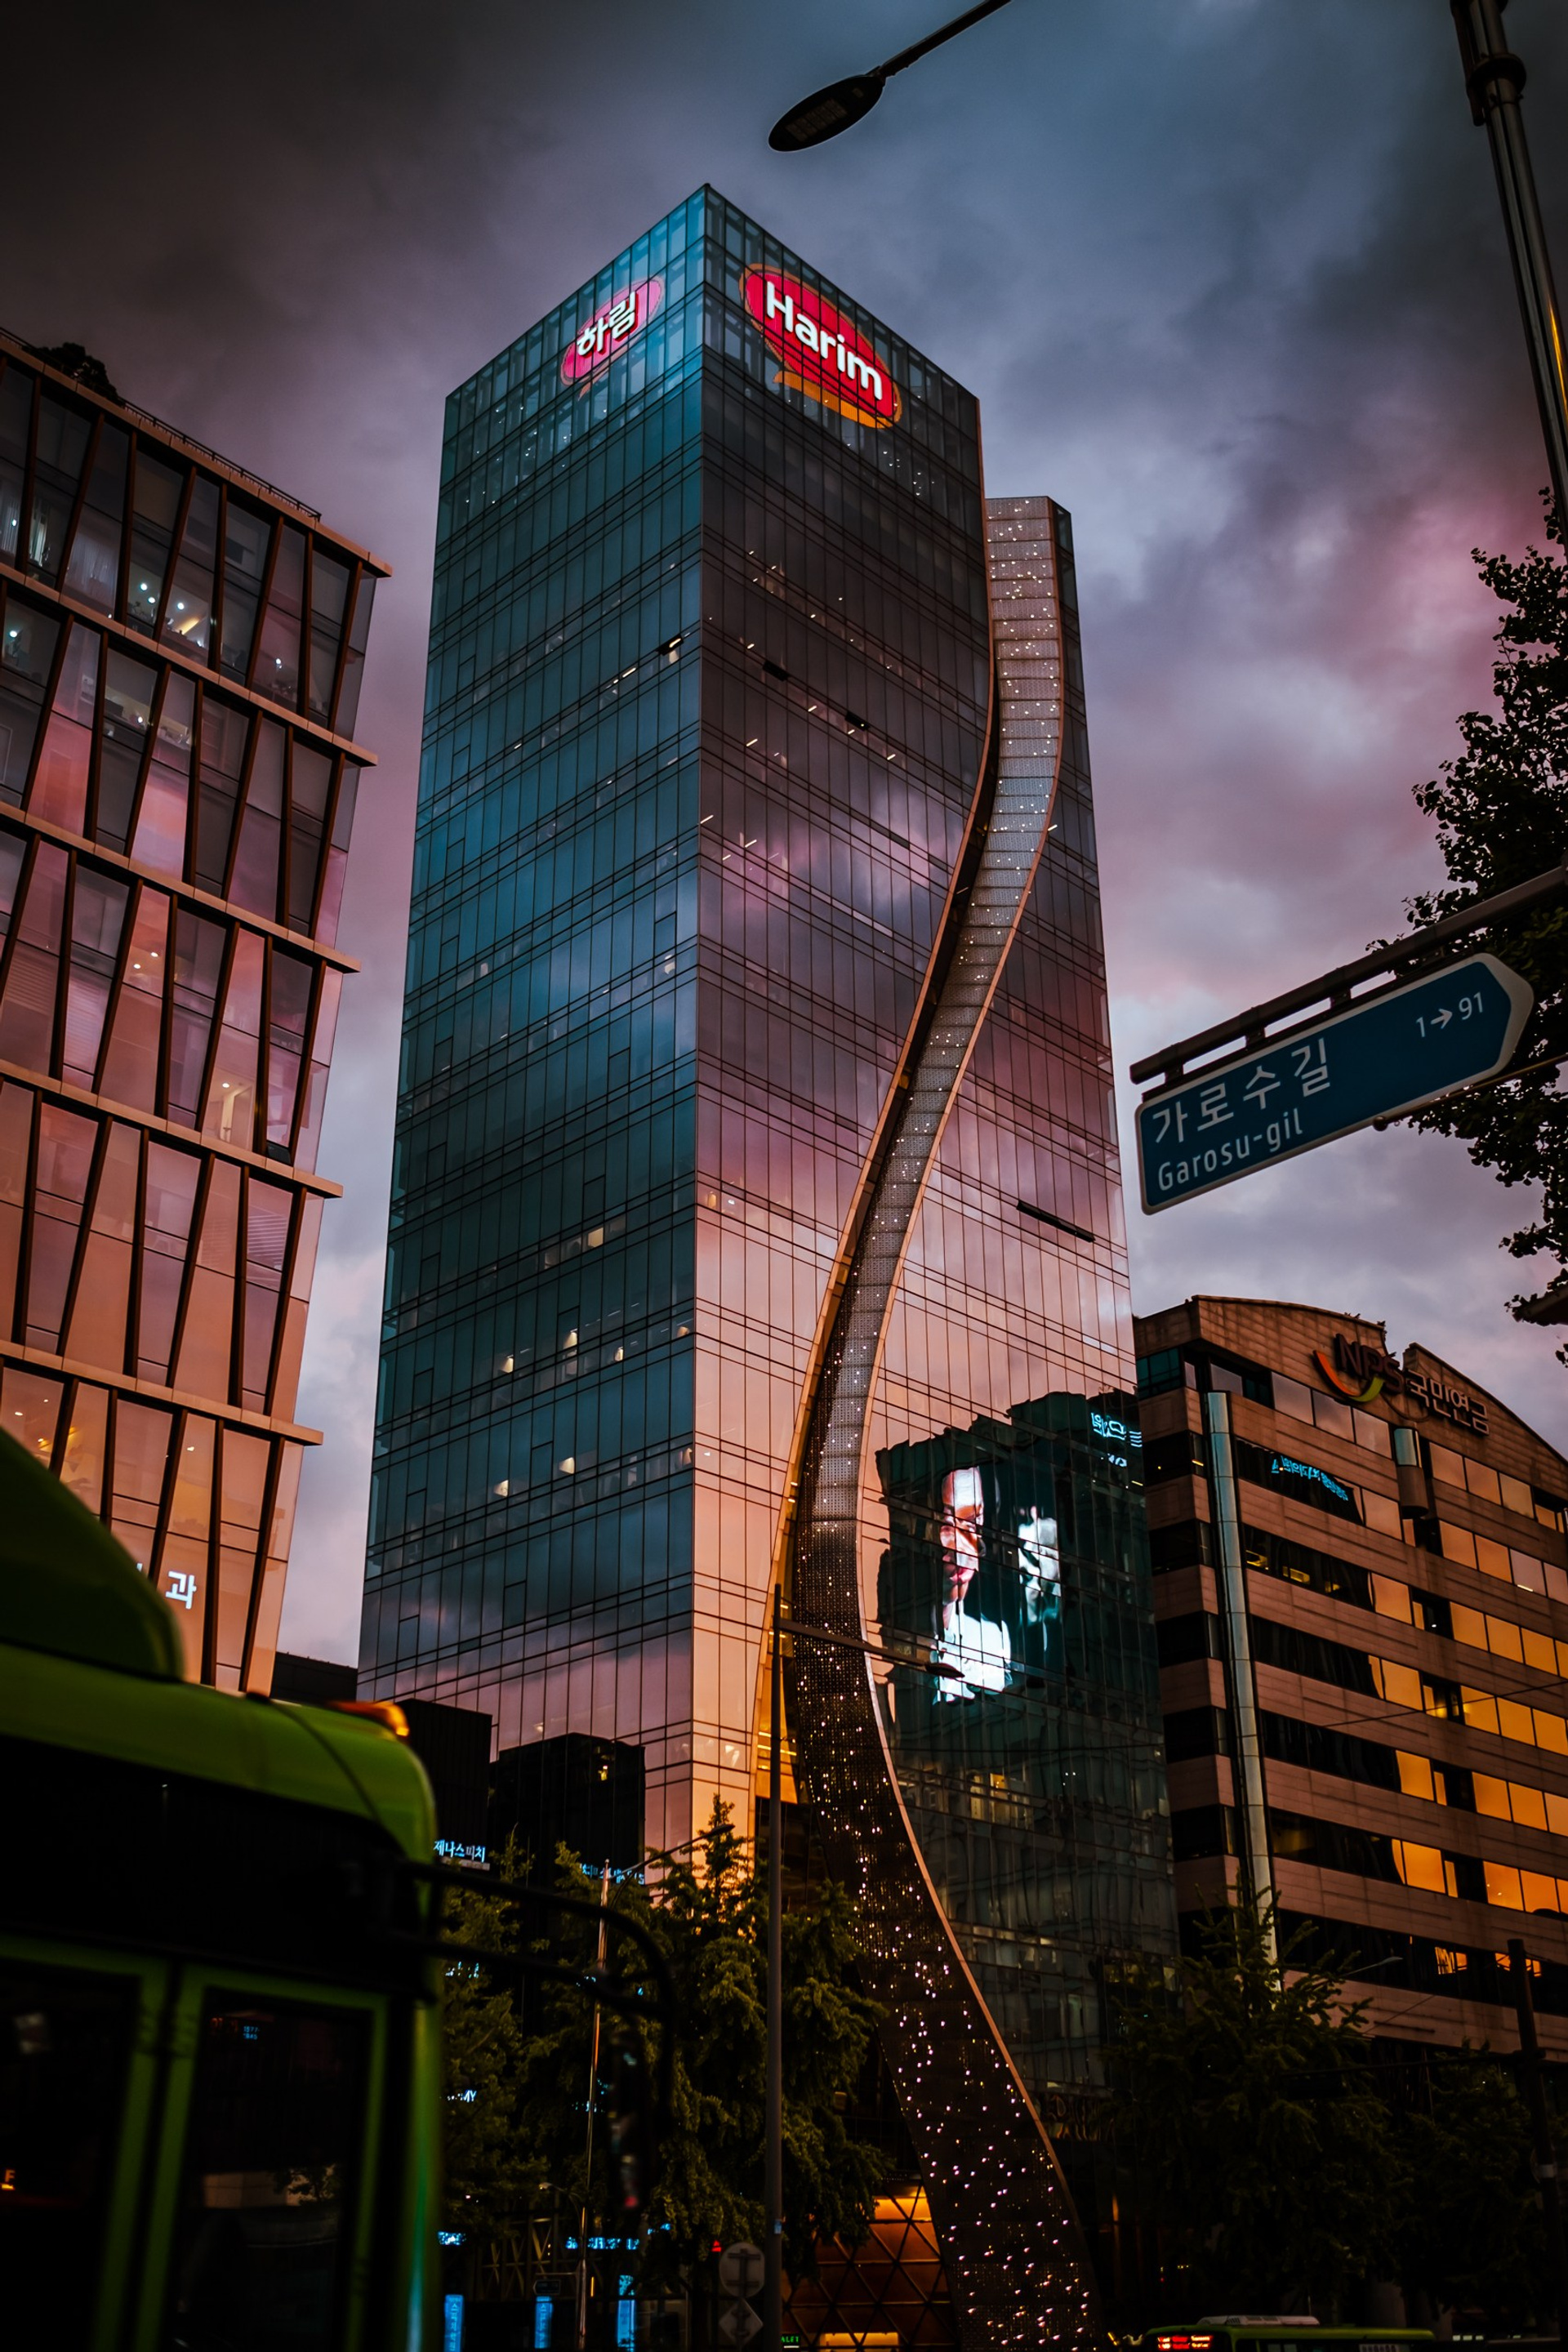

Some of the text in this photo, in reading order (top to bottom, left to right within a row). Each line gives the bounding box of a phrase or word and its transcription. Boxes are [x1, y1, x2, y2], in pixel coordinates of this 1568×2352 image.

[577, 291, 639, 357] 하림
[766, 280, 884, 401] Harim
[1152, 1037, 1331, 1144] 가로수길
[1157, 1107, 1303, 1192] Garosu-gil
[1334, 1334, 1406, 1395] NPS
[1405, 1368, 1490, 1436] 국민연금
